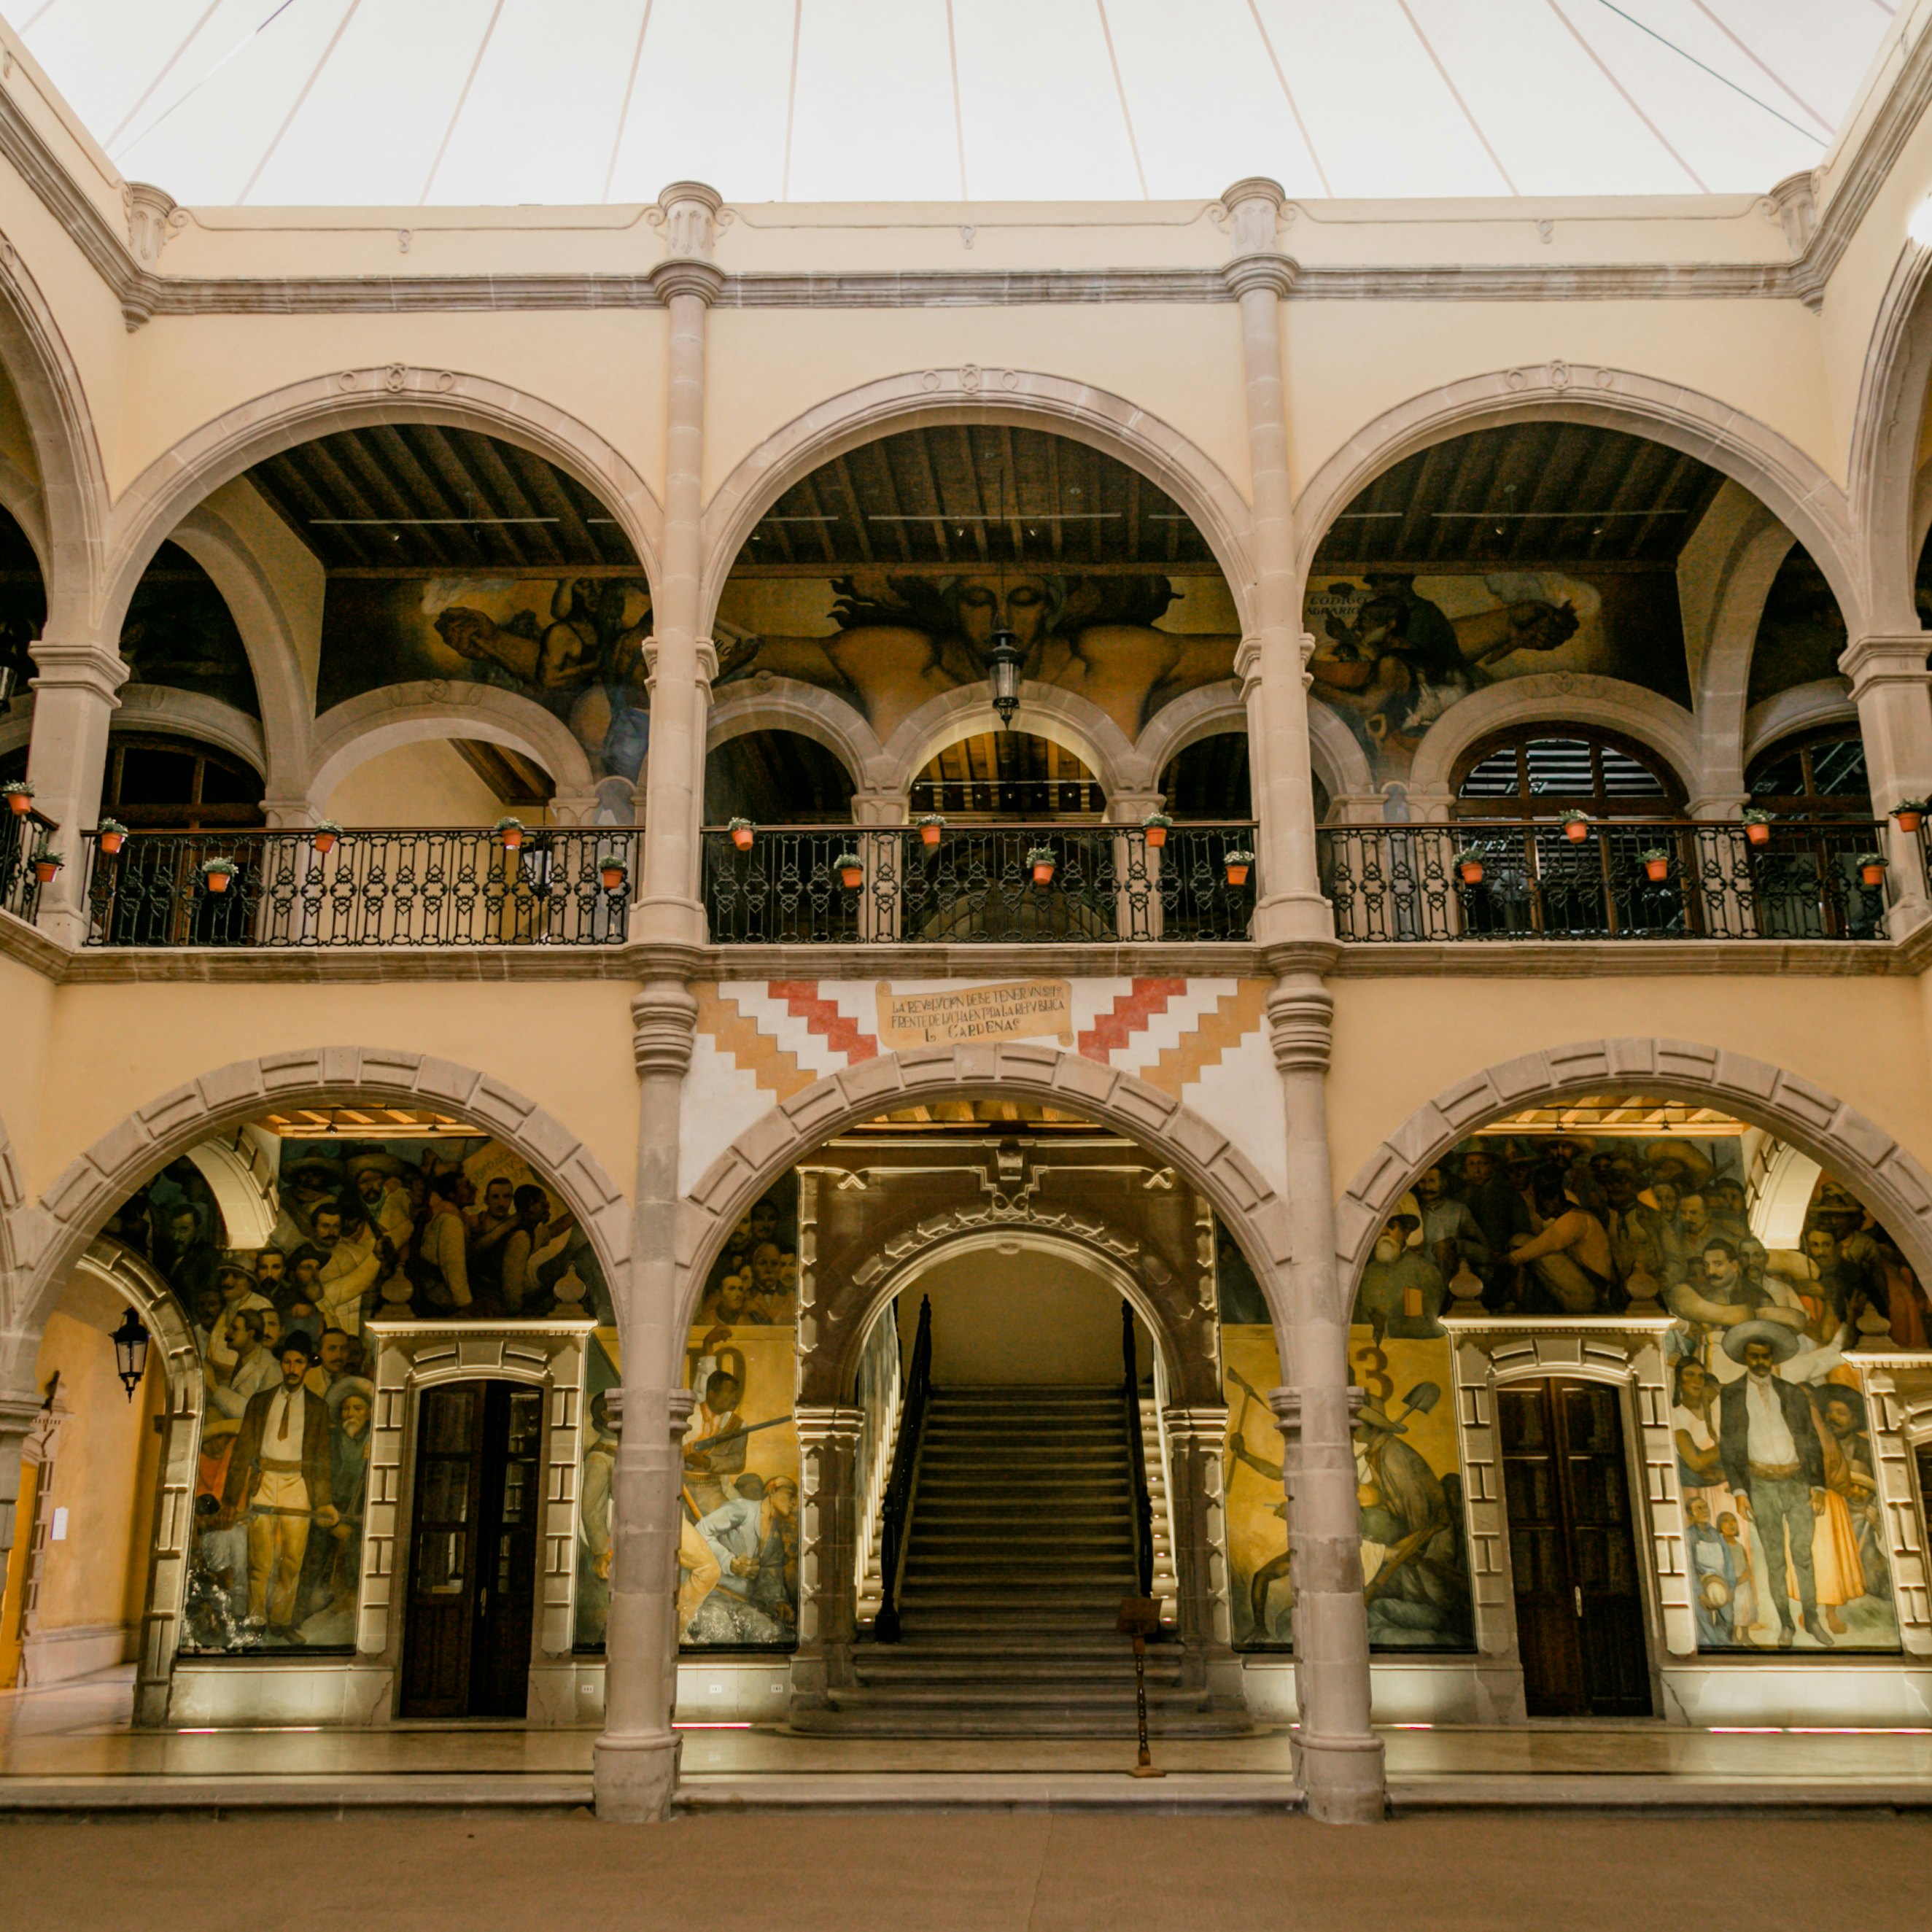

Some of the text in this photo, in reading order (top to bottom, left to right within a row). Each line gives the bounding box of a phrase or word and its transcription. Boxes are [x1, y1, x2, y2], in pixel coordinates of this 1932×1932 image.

[892, 1001, 905, 1013] LA
[966, 992, 991, 1006] DEBE
[993, 987, 1027, 1003] TENER
[891, 1015, 927, 1028] FRENTE
[928, 1013, 941, 1027] DE
[1001, 1004, 1014, 1017] LA
